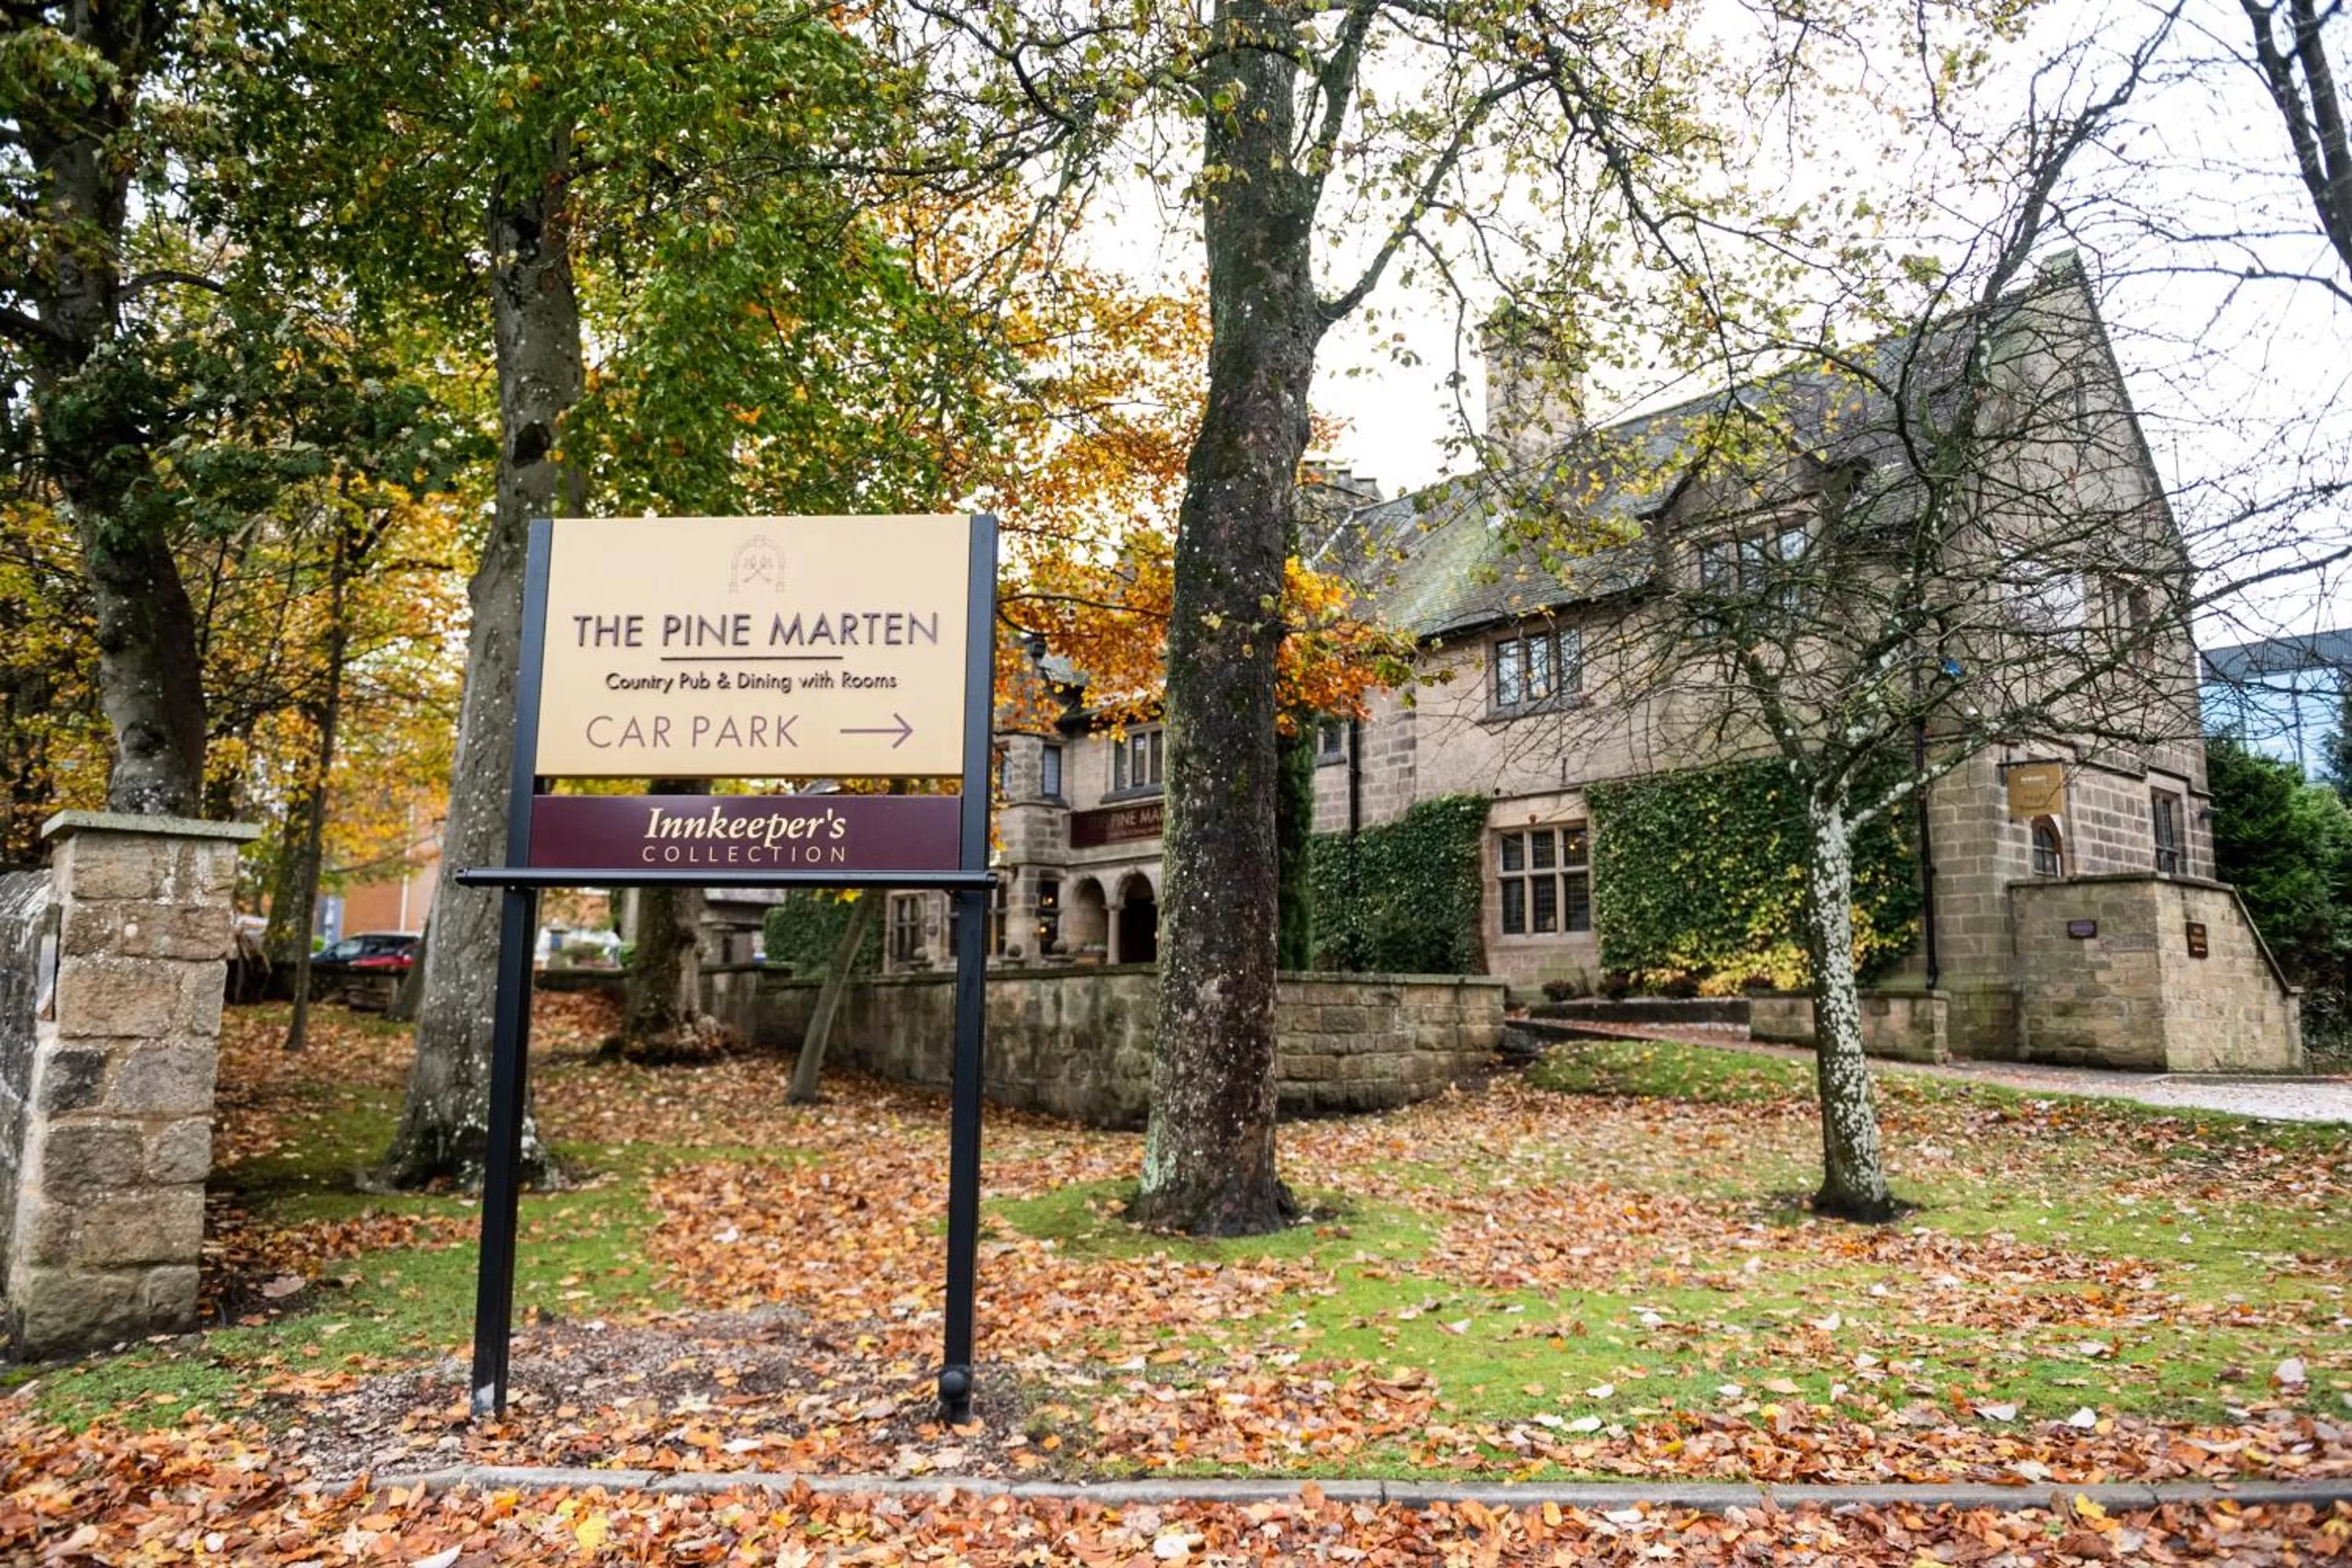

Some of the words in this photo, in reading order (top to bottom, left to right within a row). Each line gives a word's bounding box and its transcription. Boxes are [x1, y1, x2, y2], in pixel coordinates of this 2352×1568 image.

[573, 615, 644, 647] THE
[662, 614, 751, 647] PINE
[769, 612, 938, 646] MARTEN
[605, 672, 674, 694] Country
[679, 670, 710, 689] Pub
[717, 671, 731, 689] &
[737, 672, 792, 694] Dining
[800, 670, 834, 689] with
[841, 671, 898, 689] Rooms
[586, 715, 671, 749] CAR
[691, 715, 799, 748] PARK
[644, 805, 847, 848] Innkeeper's
[642, 846, 846, 862] COLLECTION
